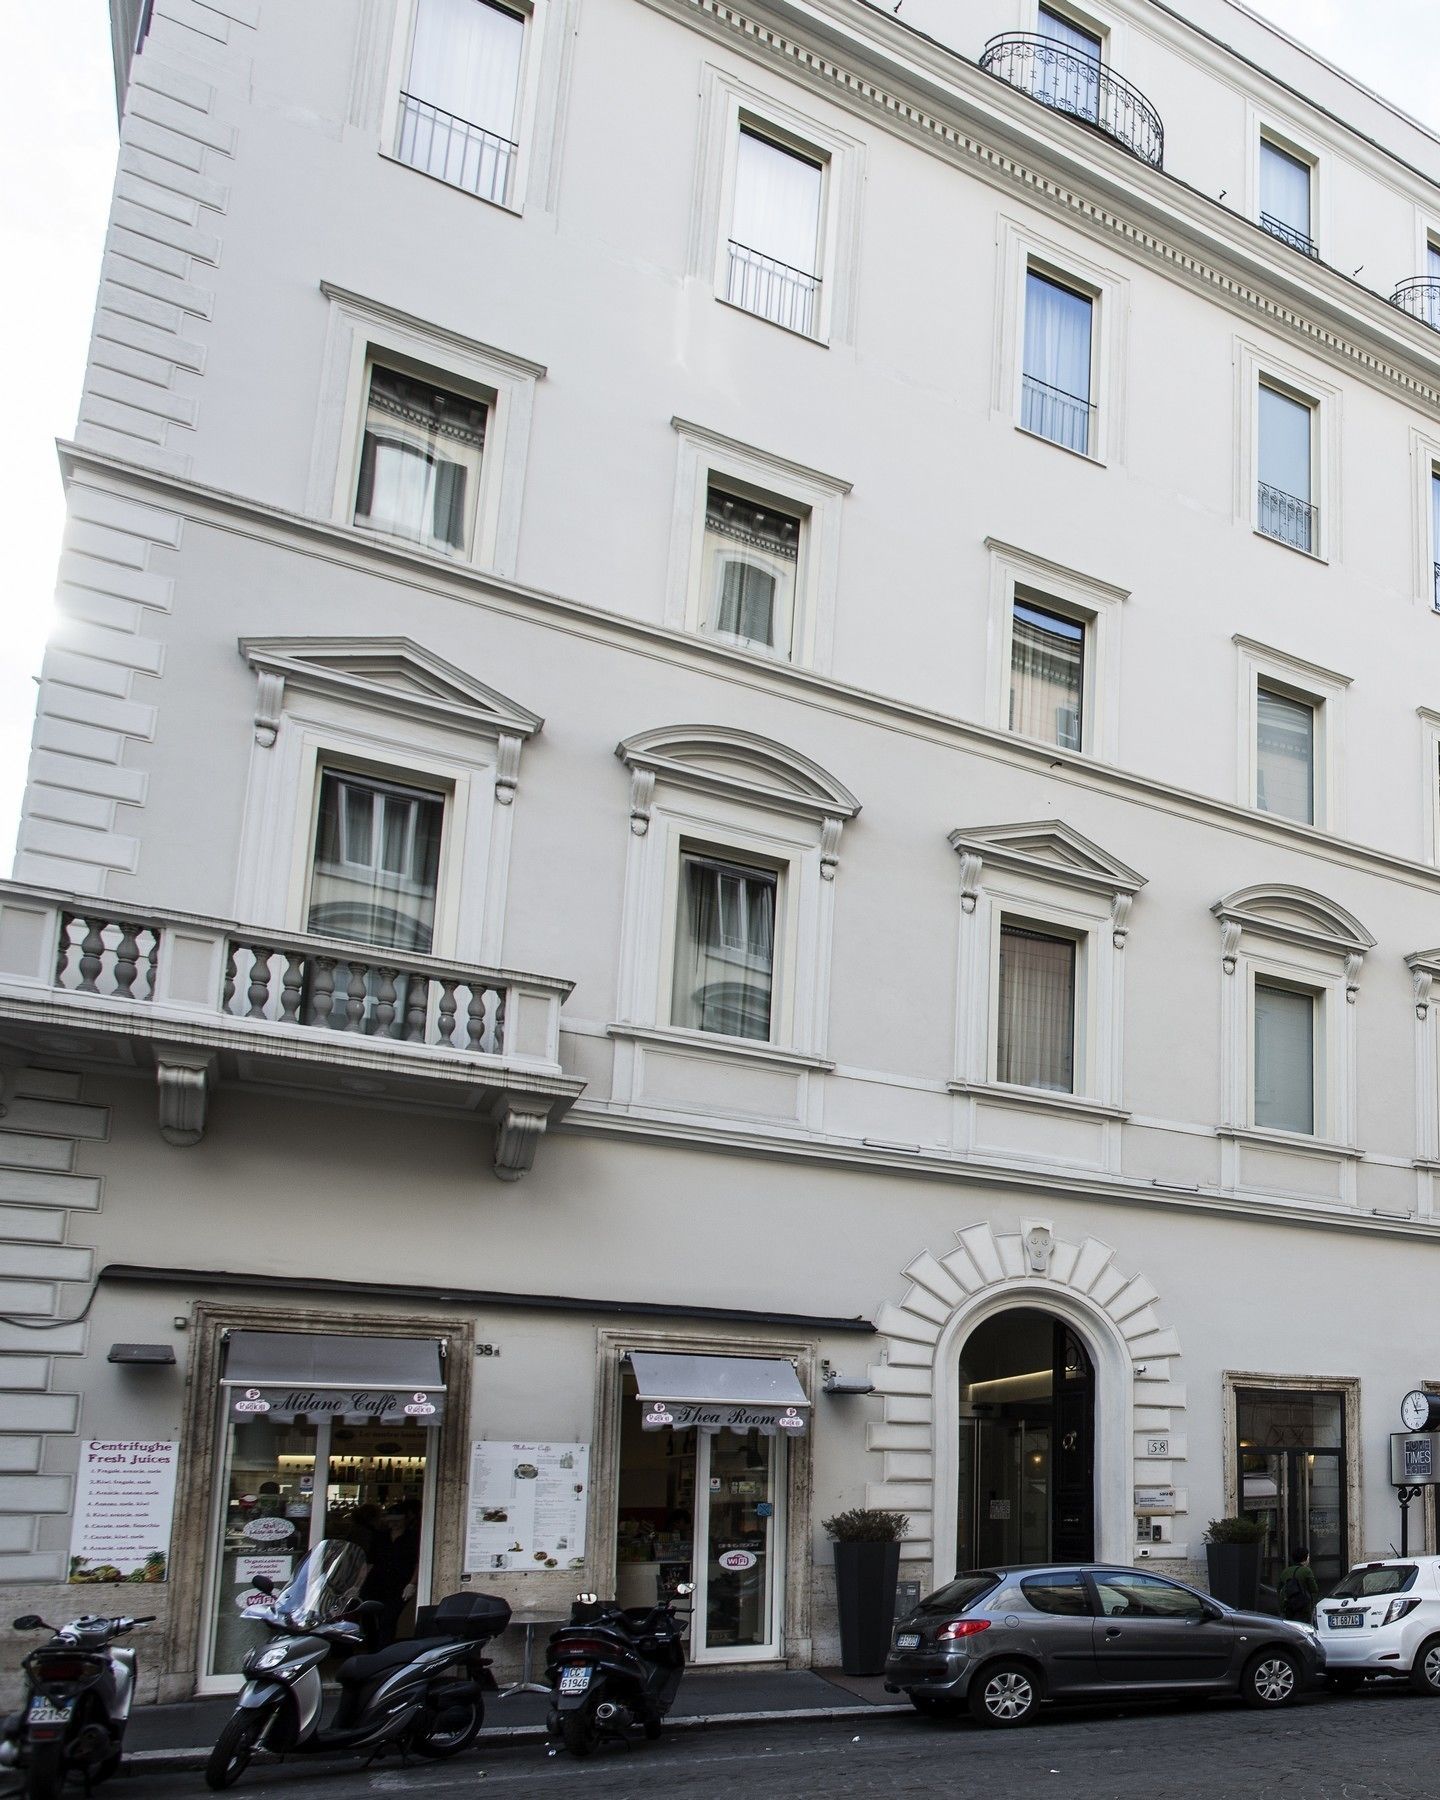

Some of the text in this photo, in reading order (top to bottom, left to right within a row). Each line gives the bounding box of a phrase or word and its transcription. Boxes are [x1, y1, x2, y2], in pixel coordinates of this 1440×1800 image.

[475, 1344, 493, 1357] 58
[272, 1391, 398, 1416] Milano Caffè
[677, 1406, 720, 1424] Thea
[727, 1408, 776, 1425] Room
[90, 1441, 172, 1453] Centrifughe
[1151, 1442, 1166, 1453] 58
[88, 1453, 171, 1465] Fresh Juices
[1405, 1450, 1431, 1464] TIMES
[561, 1678, 588, 1688] 61946
